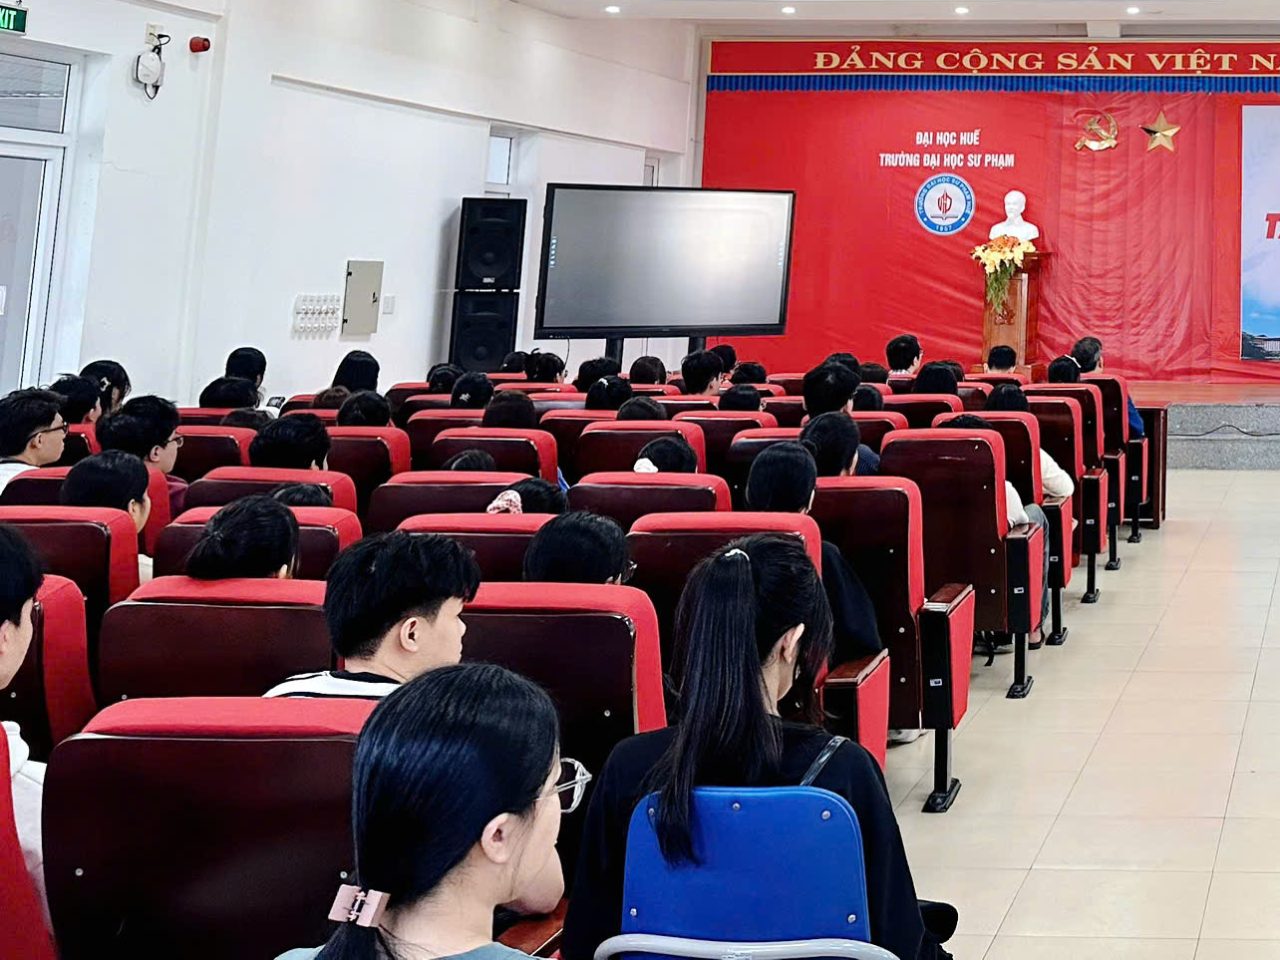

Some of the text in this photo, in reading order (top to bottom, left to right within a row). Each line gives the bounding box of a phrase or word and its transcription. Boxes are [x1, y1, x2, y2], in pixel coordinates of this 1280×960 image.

[813, 45, 924, 70] ĐẢNG
[936, 48, 1044, 74] CỘNG
[1057, 46, 1135, 71] SẢN
[1147, 49, 1237, 74] VIỆT
[915, 128, 981, 148] ĐẠI HỌC HUẾ
[879, 151, 1015, 169] TRƯỜNG ĐẠI HỌC SƯ PHẠM
